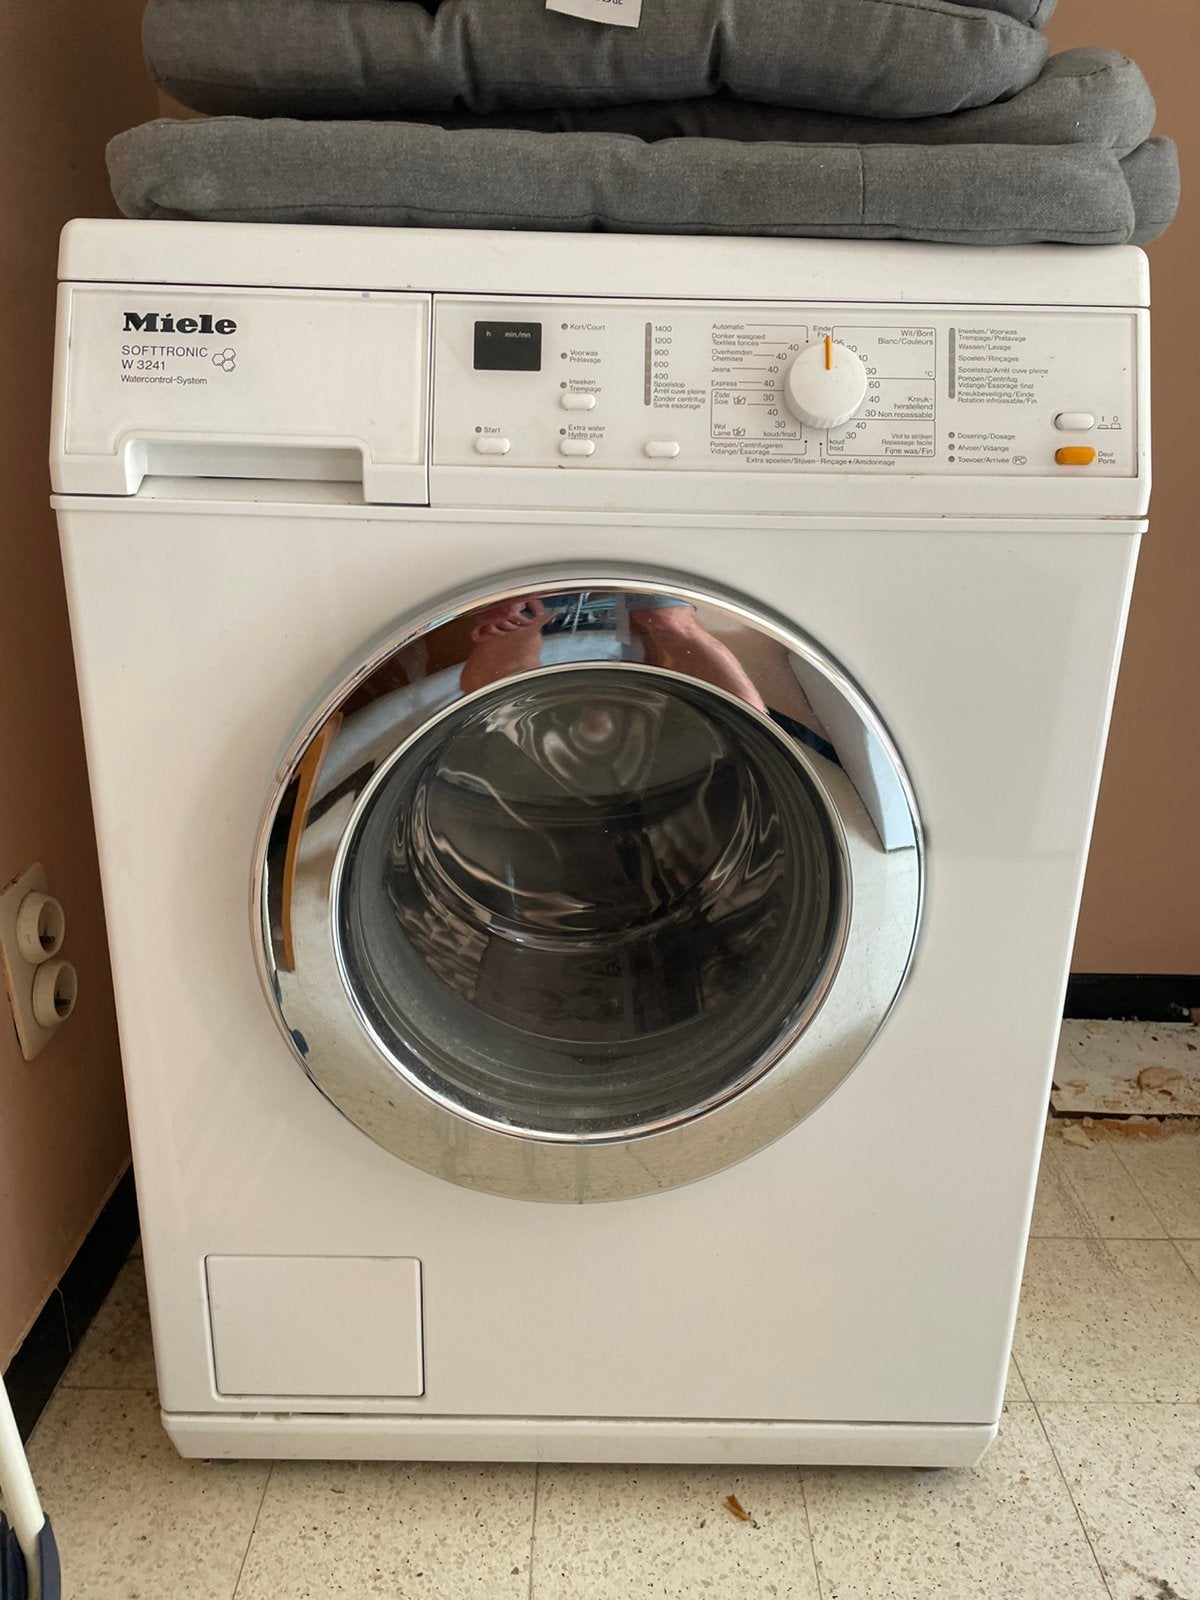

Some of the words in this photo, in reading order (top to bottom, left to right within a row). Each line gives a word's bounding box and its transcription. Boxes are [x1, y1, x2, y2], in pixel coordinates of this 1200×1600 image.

[123, 312, 237, 335] Miele
[570, 323, 605, 331] Kort/Court
[901, 329, 934, 337] Wit/Bont
[878, 337, 934, 345] Blanc/Couleurs
[121, 345, 208, 358] SOFTTRONIC
[776, 352, 787, 360] 40
[121, 360, 134, 370] W
[136, 360, 165, 371] 3241
[866, 367, 877, 375] 30
[121, 374, 208, 386] Watercontrol-System
[865, 409, 876, 417] 30
[855, 421, 867, 429] 40
[845, 431, 857, 439] 30
[885, 447, 903, 455] Fijne
[1097, 457, 1117, 465] Porte
